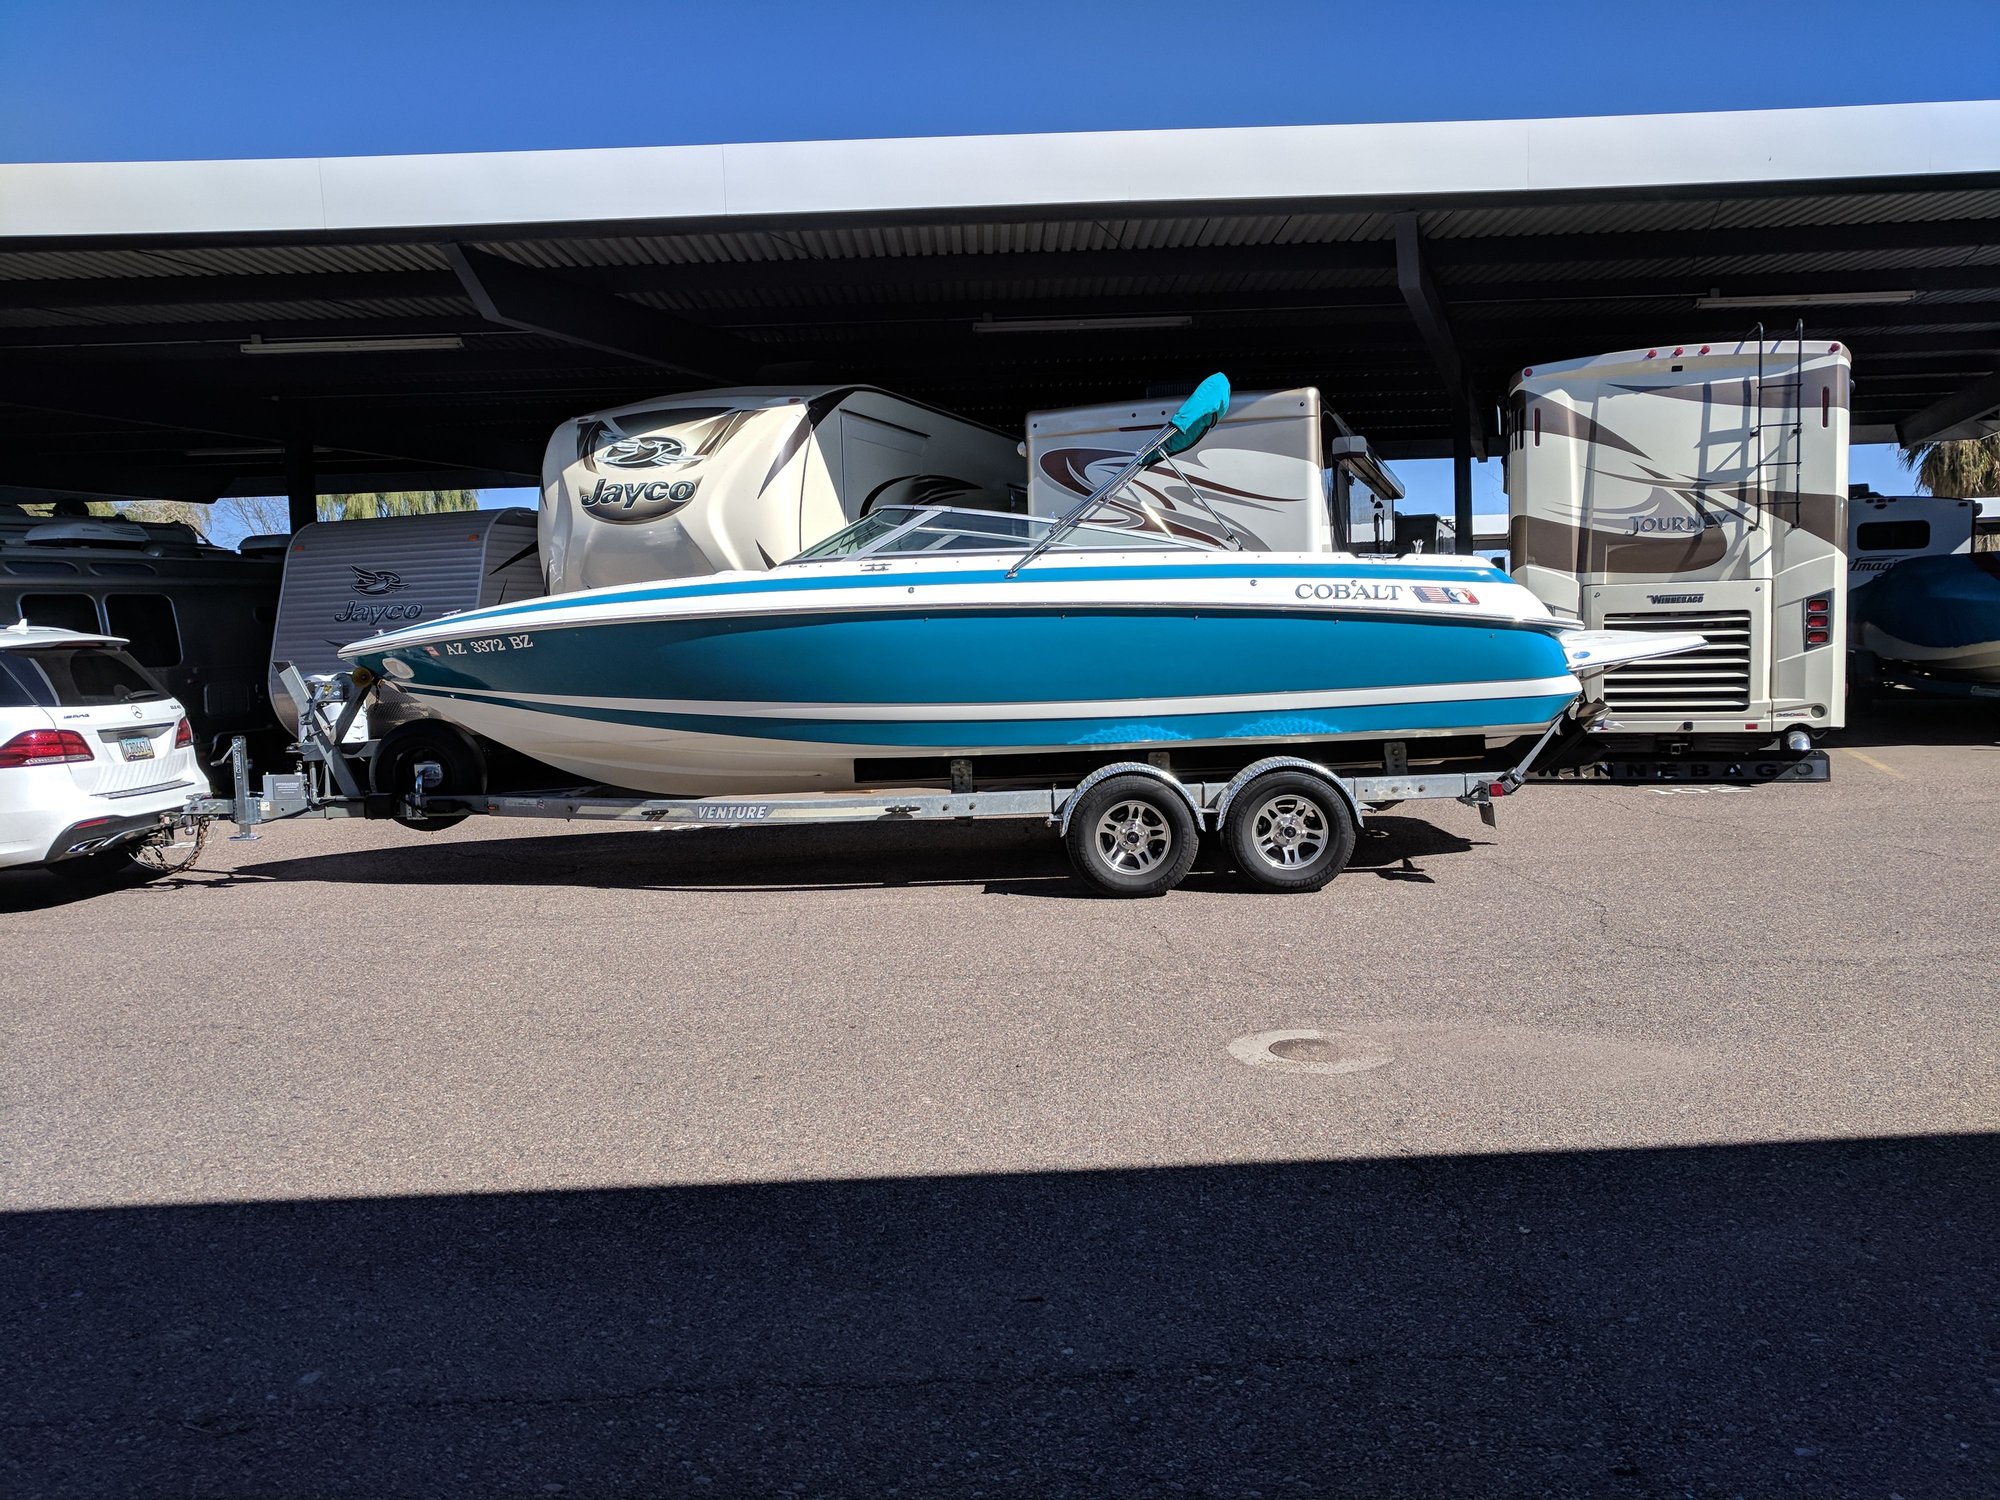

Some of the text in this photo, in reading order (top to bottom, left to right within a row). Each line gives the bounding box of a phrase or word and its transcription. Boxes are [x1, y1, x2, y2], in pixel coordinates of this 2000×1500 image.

[581, 479, 697, 509] Jayco
[1625, 514, 1729, 536] JOURNEY
[1295, 584, 1403, 600] COBALT
[1646, 593, 1704, 605] WINNEBAGO
[334, 600, 423, 625] Jayco
[446, 634, 533, 655] AZ 3372 BZ
[1537, 762, 1814, 778] WINNEBAGO
[697, 806, 767, 819] VENTURE
